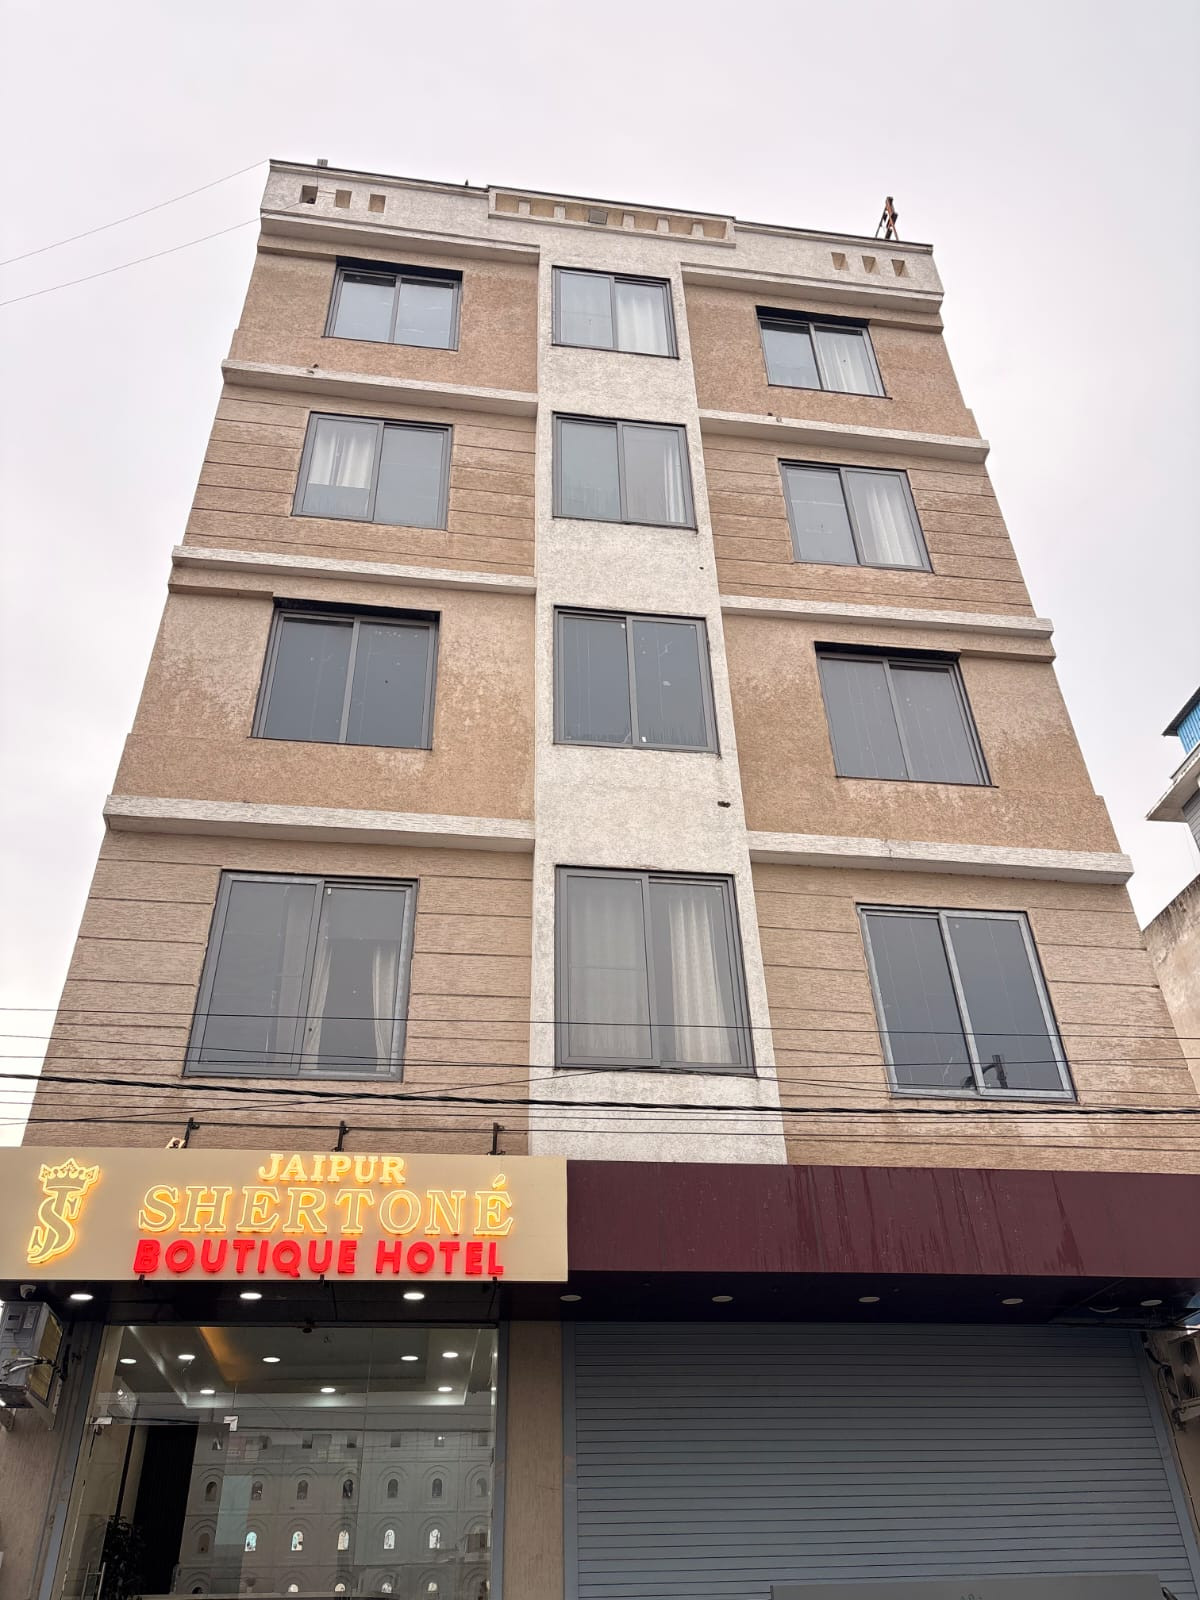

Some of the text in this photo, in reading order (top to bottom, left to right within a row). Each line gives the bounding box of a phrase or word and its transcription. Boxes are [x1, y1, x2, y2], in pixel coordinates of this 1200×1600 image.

[258, 1153, 406, 1184] JAIPUR
[137, 1173, 514, 1236] SHERTONÉ
[133, 1238, 504, 1277] BOUTIQUE HOTEL
